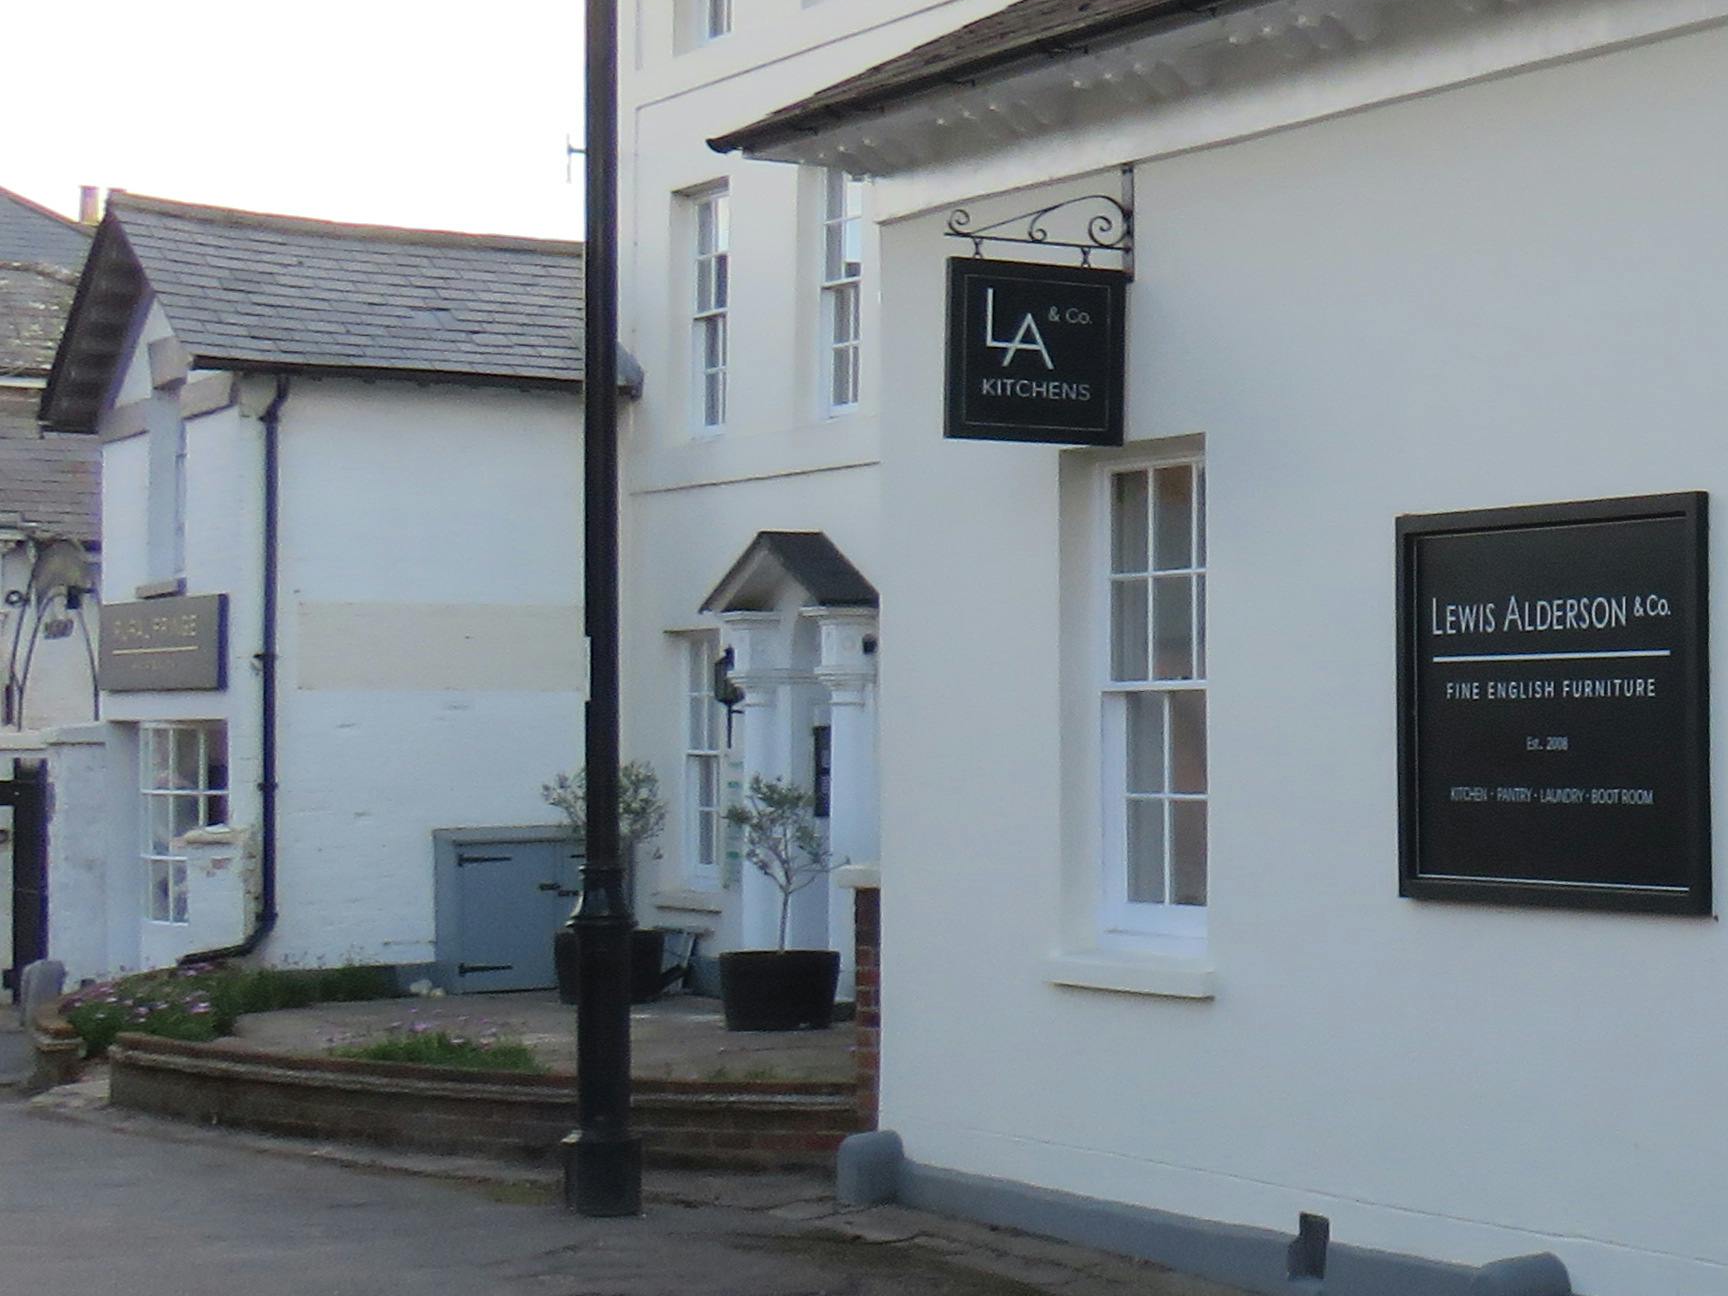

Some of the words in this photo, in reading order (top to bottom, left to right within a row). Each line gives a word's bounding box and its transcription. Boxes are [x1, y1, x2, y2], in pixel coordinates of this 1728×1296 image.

[985, 287, 1055, 371] LA
[981, 378, 1091, 401] KITCHENS
[1446, 682, 1480, 700] FINE
[1487, 680, 1555, 699] ENGLISH
[1562, 678, 1656, 698] FURNITURE
